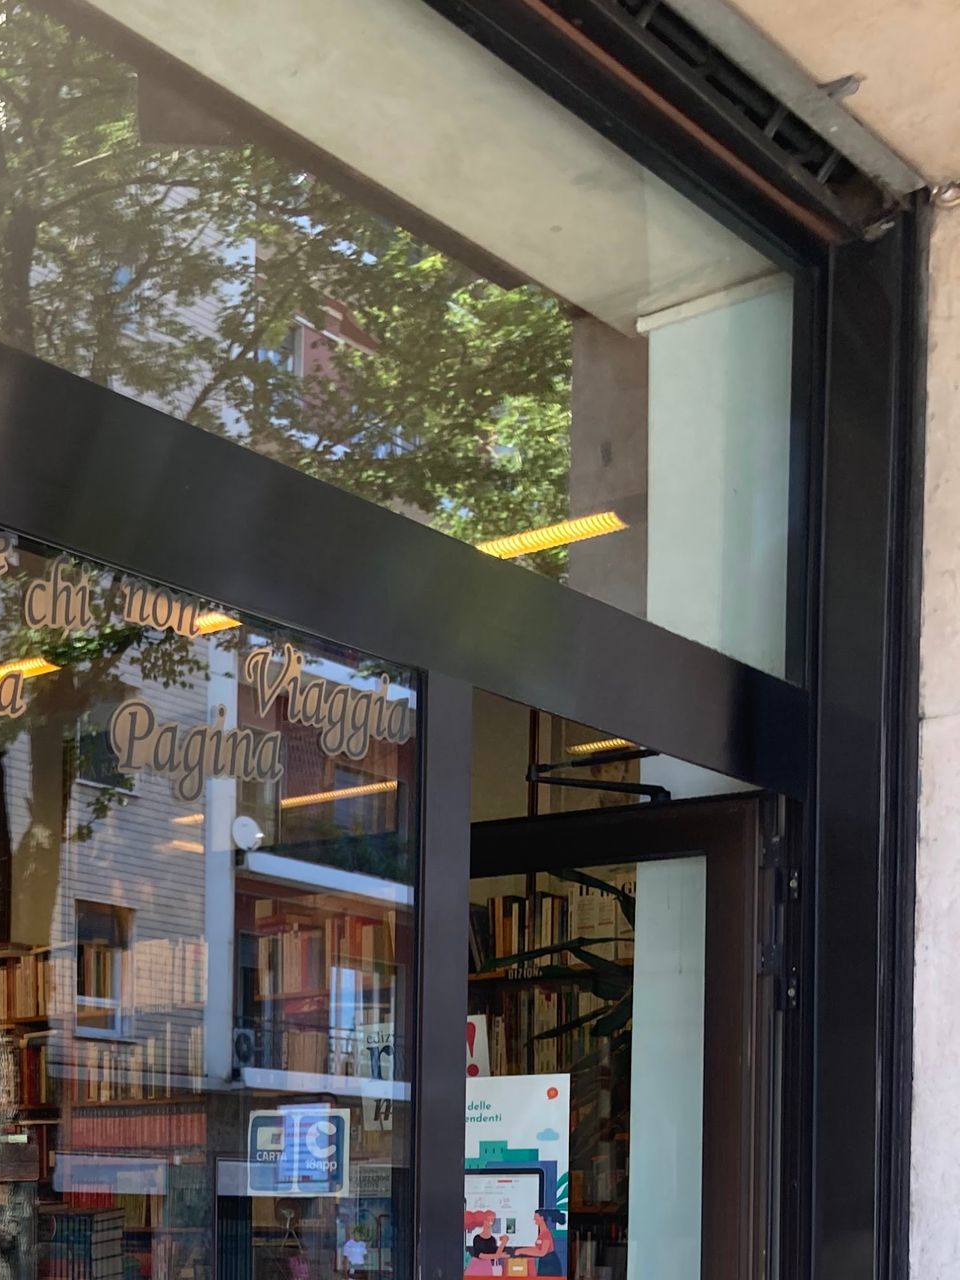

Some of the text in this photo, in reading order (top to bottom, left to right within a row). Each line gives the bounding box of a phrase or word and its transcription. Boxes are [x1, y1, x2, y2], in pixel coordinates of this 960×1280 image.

[25, 562, 90, 628] chi
[122, 583, 199, 637] non
[247, 648, 410, 758] Viaggia
[114, 704, 283, 799] Pagina
[467, 1101, 492, 1111] delle
[256, 1151, 287, 1162] CARTA
